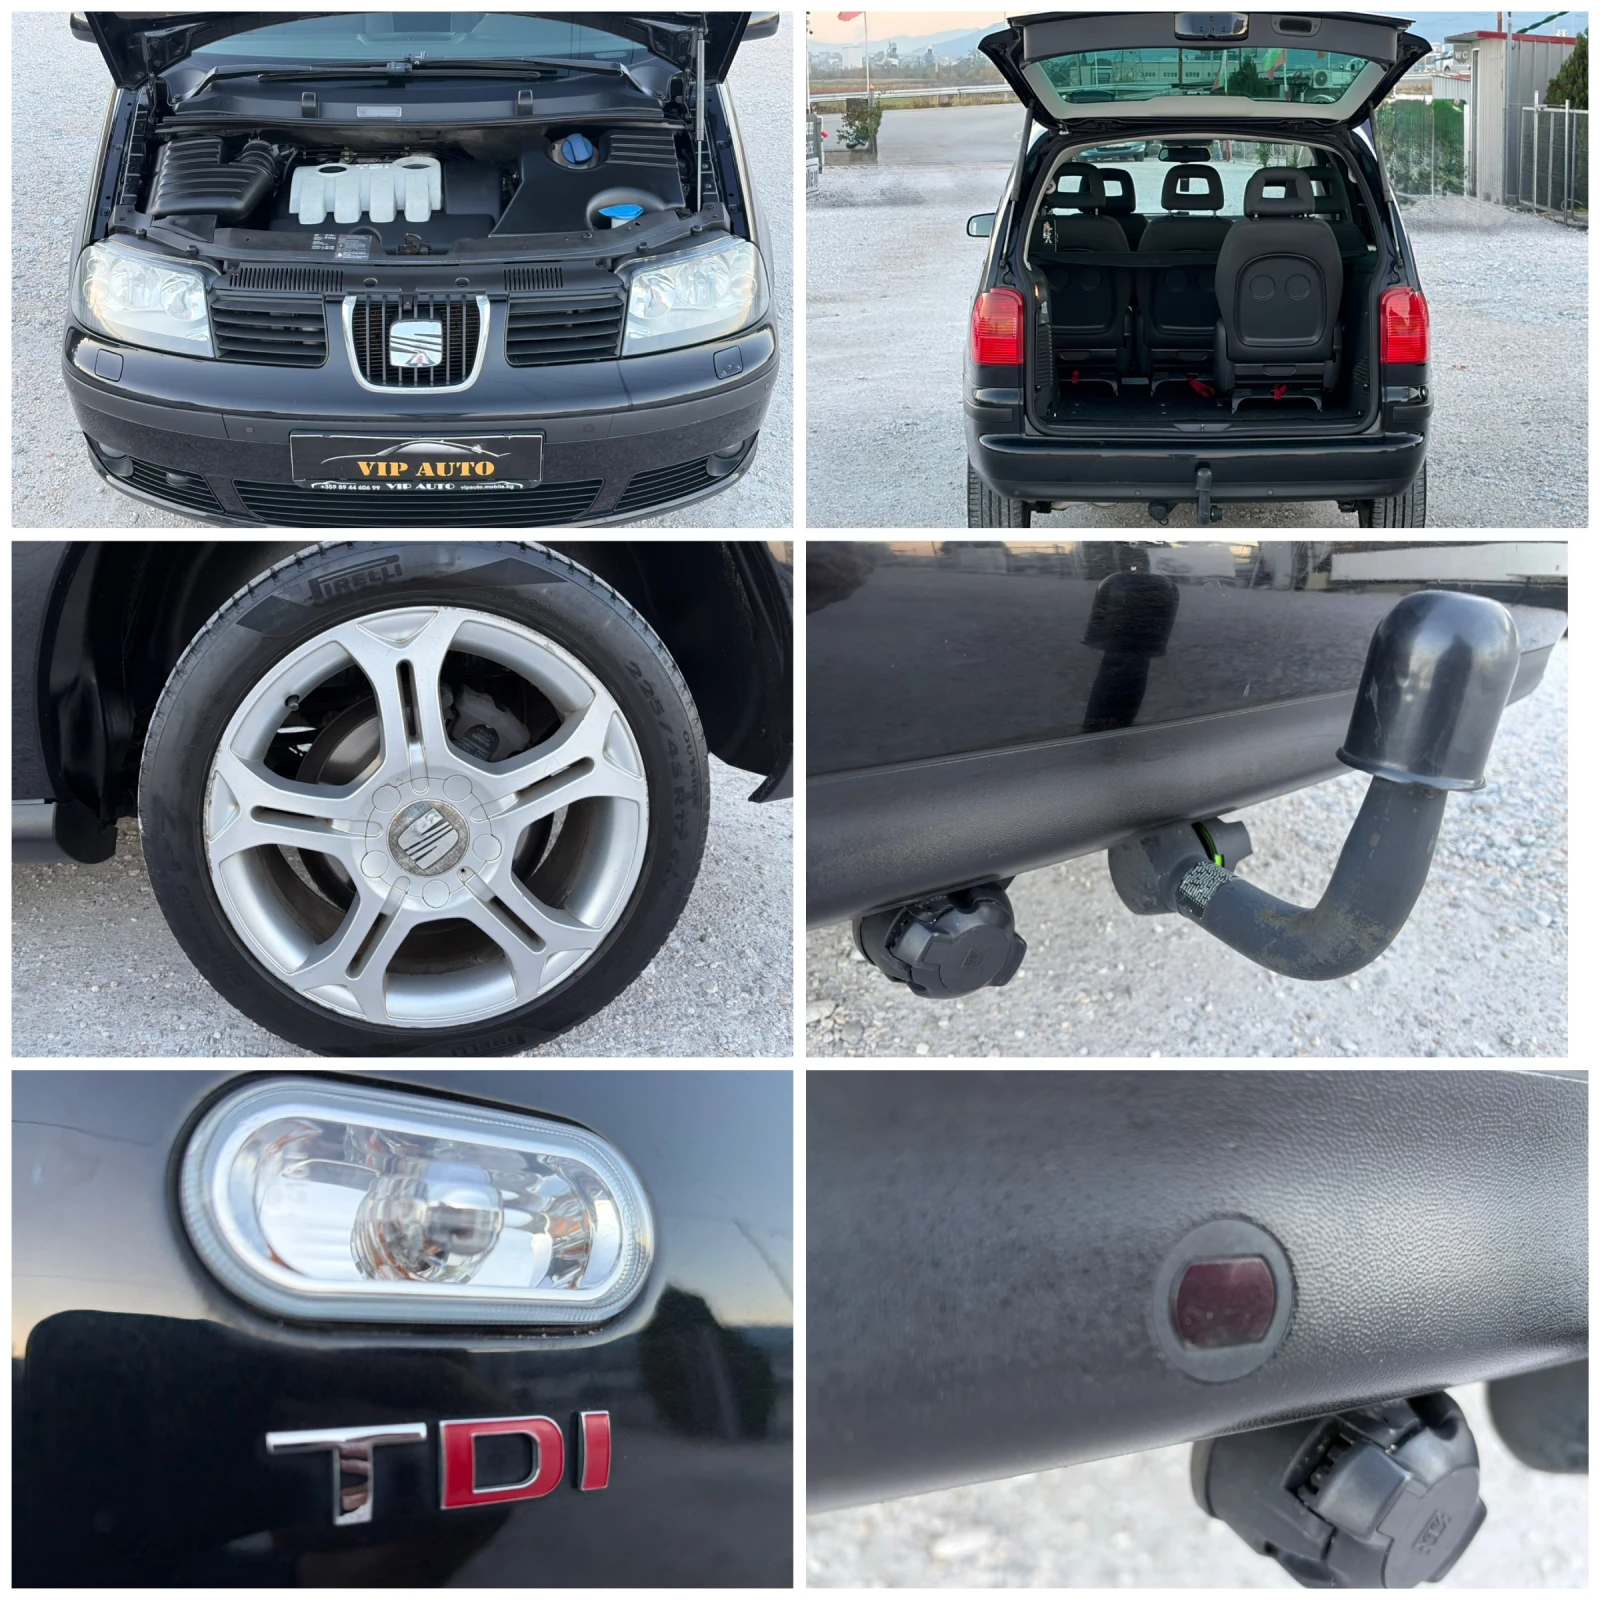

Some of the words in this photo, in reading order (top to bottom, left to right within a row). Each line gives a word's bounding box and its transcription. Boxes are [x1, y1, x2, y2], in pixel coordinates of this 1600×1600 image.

[1454, 50, 1468, 60] WC
[357, 461, 409, 477] VIP
[415, 461, 495, 477] AUTO
[386, 482, 412, 490] VIP
[415, 482, 456, 490] AUTO
[308, 554, 404, 604] PIRELLI
[683, 730, 699, 806] OUTSIDE
[265, 1410, 610, 1528] TDI
